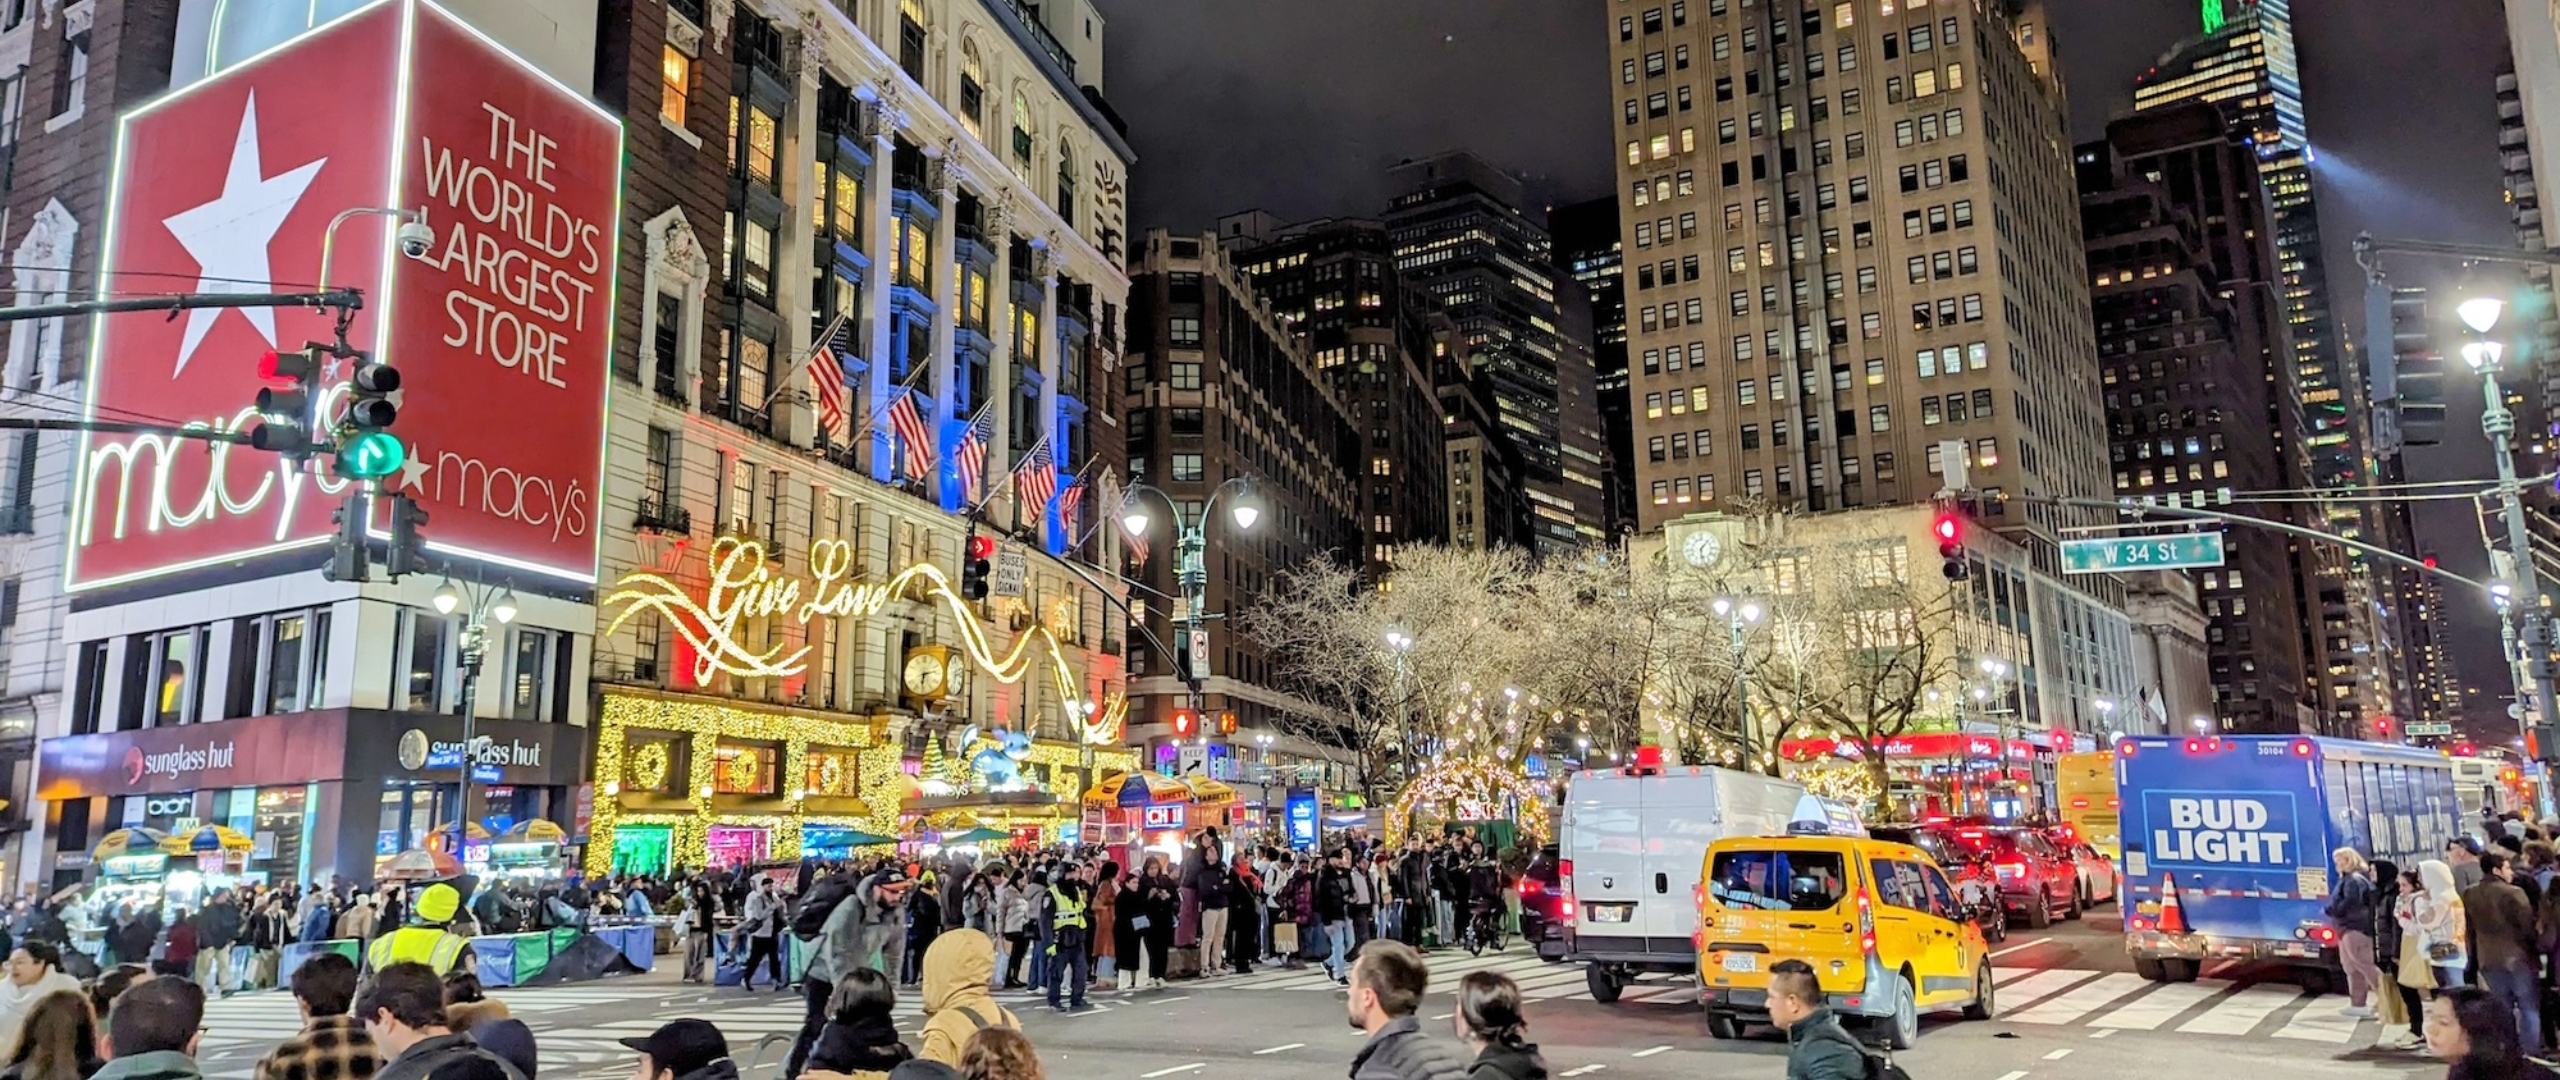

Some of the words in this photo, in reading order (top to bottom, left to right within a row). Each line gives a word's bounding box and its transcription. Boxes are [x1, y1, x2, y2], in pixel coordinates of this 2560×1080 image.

[481, 101, 557, 193] THE
[422, 135, 600, 275] WORLD'S
[419, 204, 594, 332] LARGEST
[443, 289, 568, 389] STORE
[436, 450, 586, 543] macy's
[1000, 554, 1025, 568] BUSES
[2103, 545, 2118, 564] W
[2126, 544, 2150, 563] 34
[2157, 542, 2178, 562] St
[997, 581, 1020, 594] SIGNAL
[1000, 568, 1021, 580] ONLY
[694, 536, 801, 687] Give
[799, 538, 890, 625] Love
[144, 743, 206, 780] sunglass
[207, 740, 235, 769] hut
[512, 738, 541, 766] hut
[1184, 749, 1204, 758] KEEP
[2258, 747, 2284, 755] 30104
[2170, 798, 2268, 830] BUD
[2154, 829, 2289, 864] LIGHT
